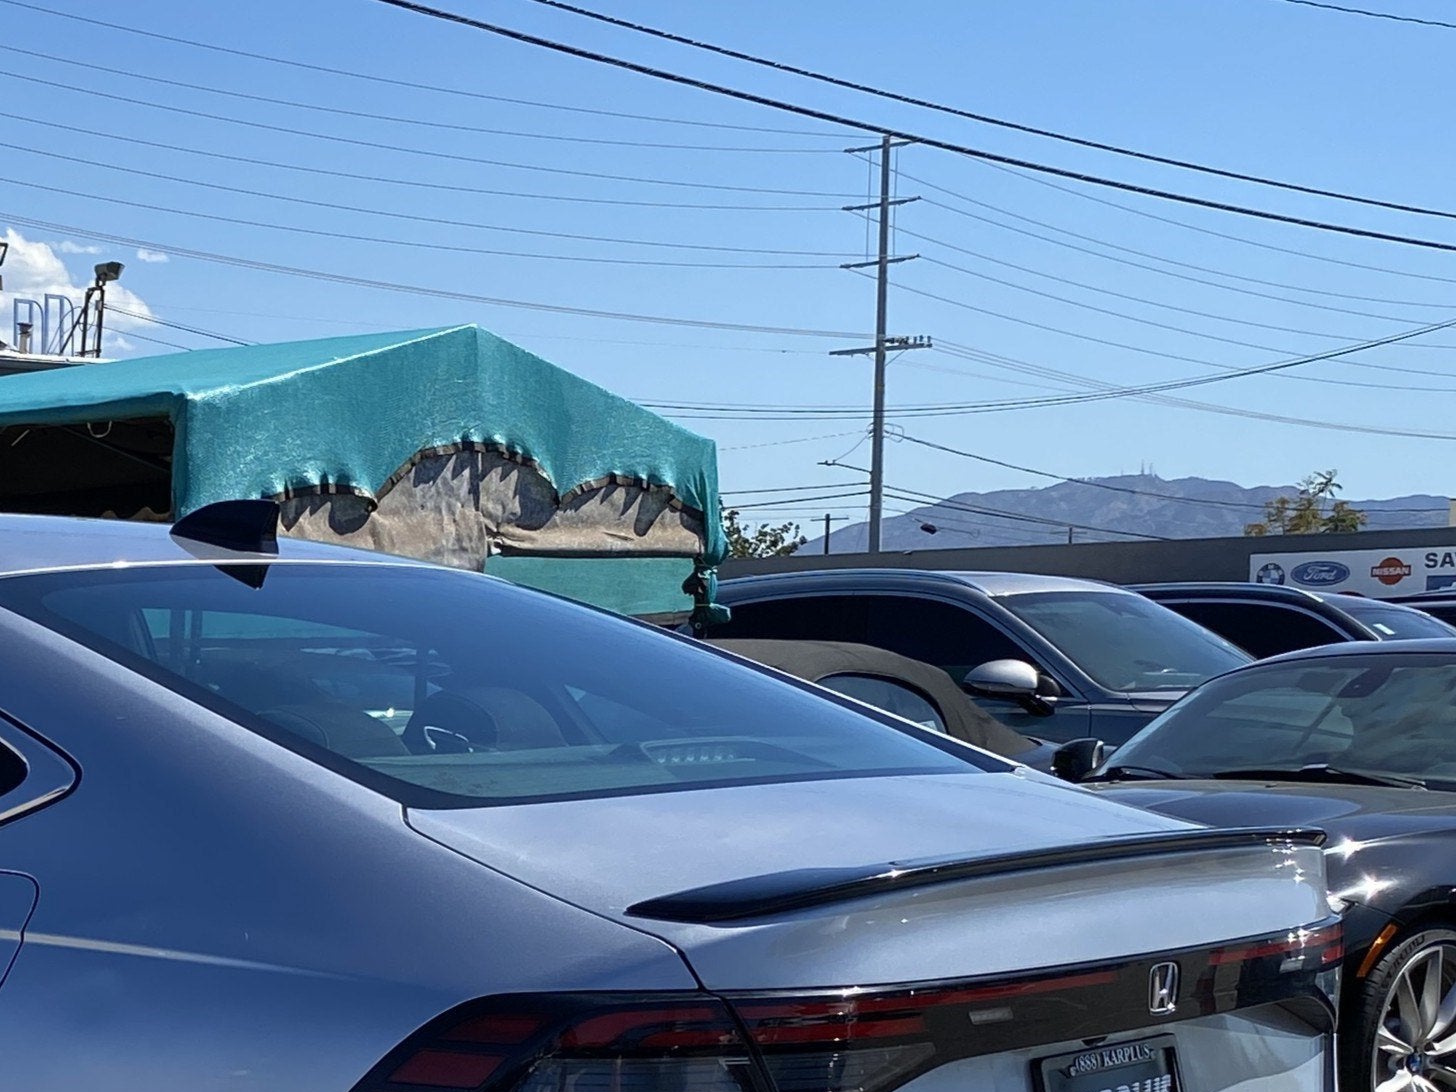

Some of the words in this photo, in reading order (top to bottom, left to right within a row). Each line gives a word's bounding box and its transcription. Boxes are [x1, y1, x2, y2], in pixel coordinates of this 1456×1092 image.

[1424, 551, 1456, 569] SA
[1302, 567, 1337, 582] Ford
[1372, 566, 1411, 576] NISSAN
[1075, 1052, 1101, 1073] (888)
[1103, 1043, 1150, 1067] KARPLUS
